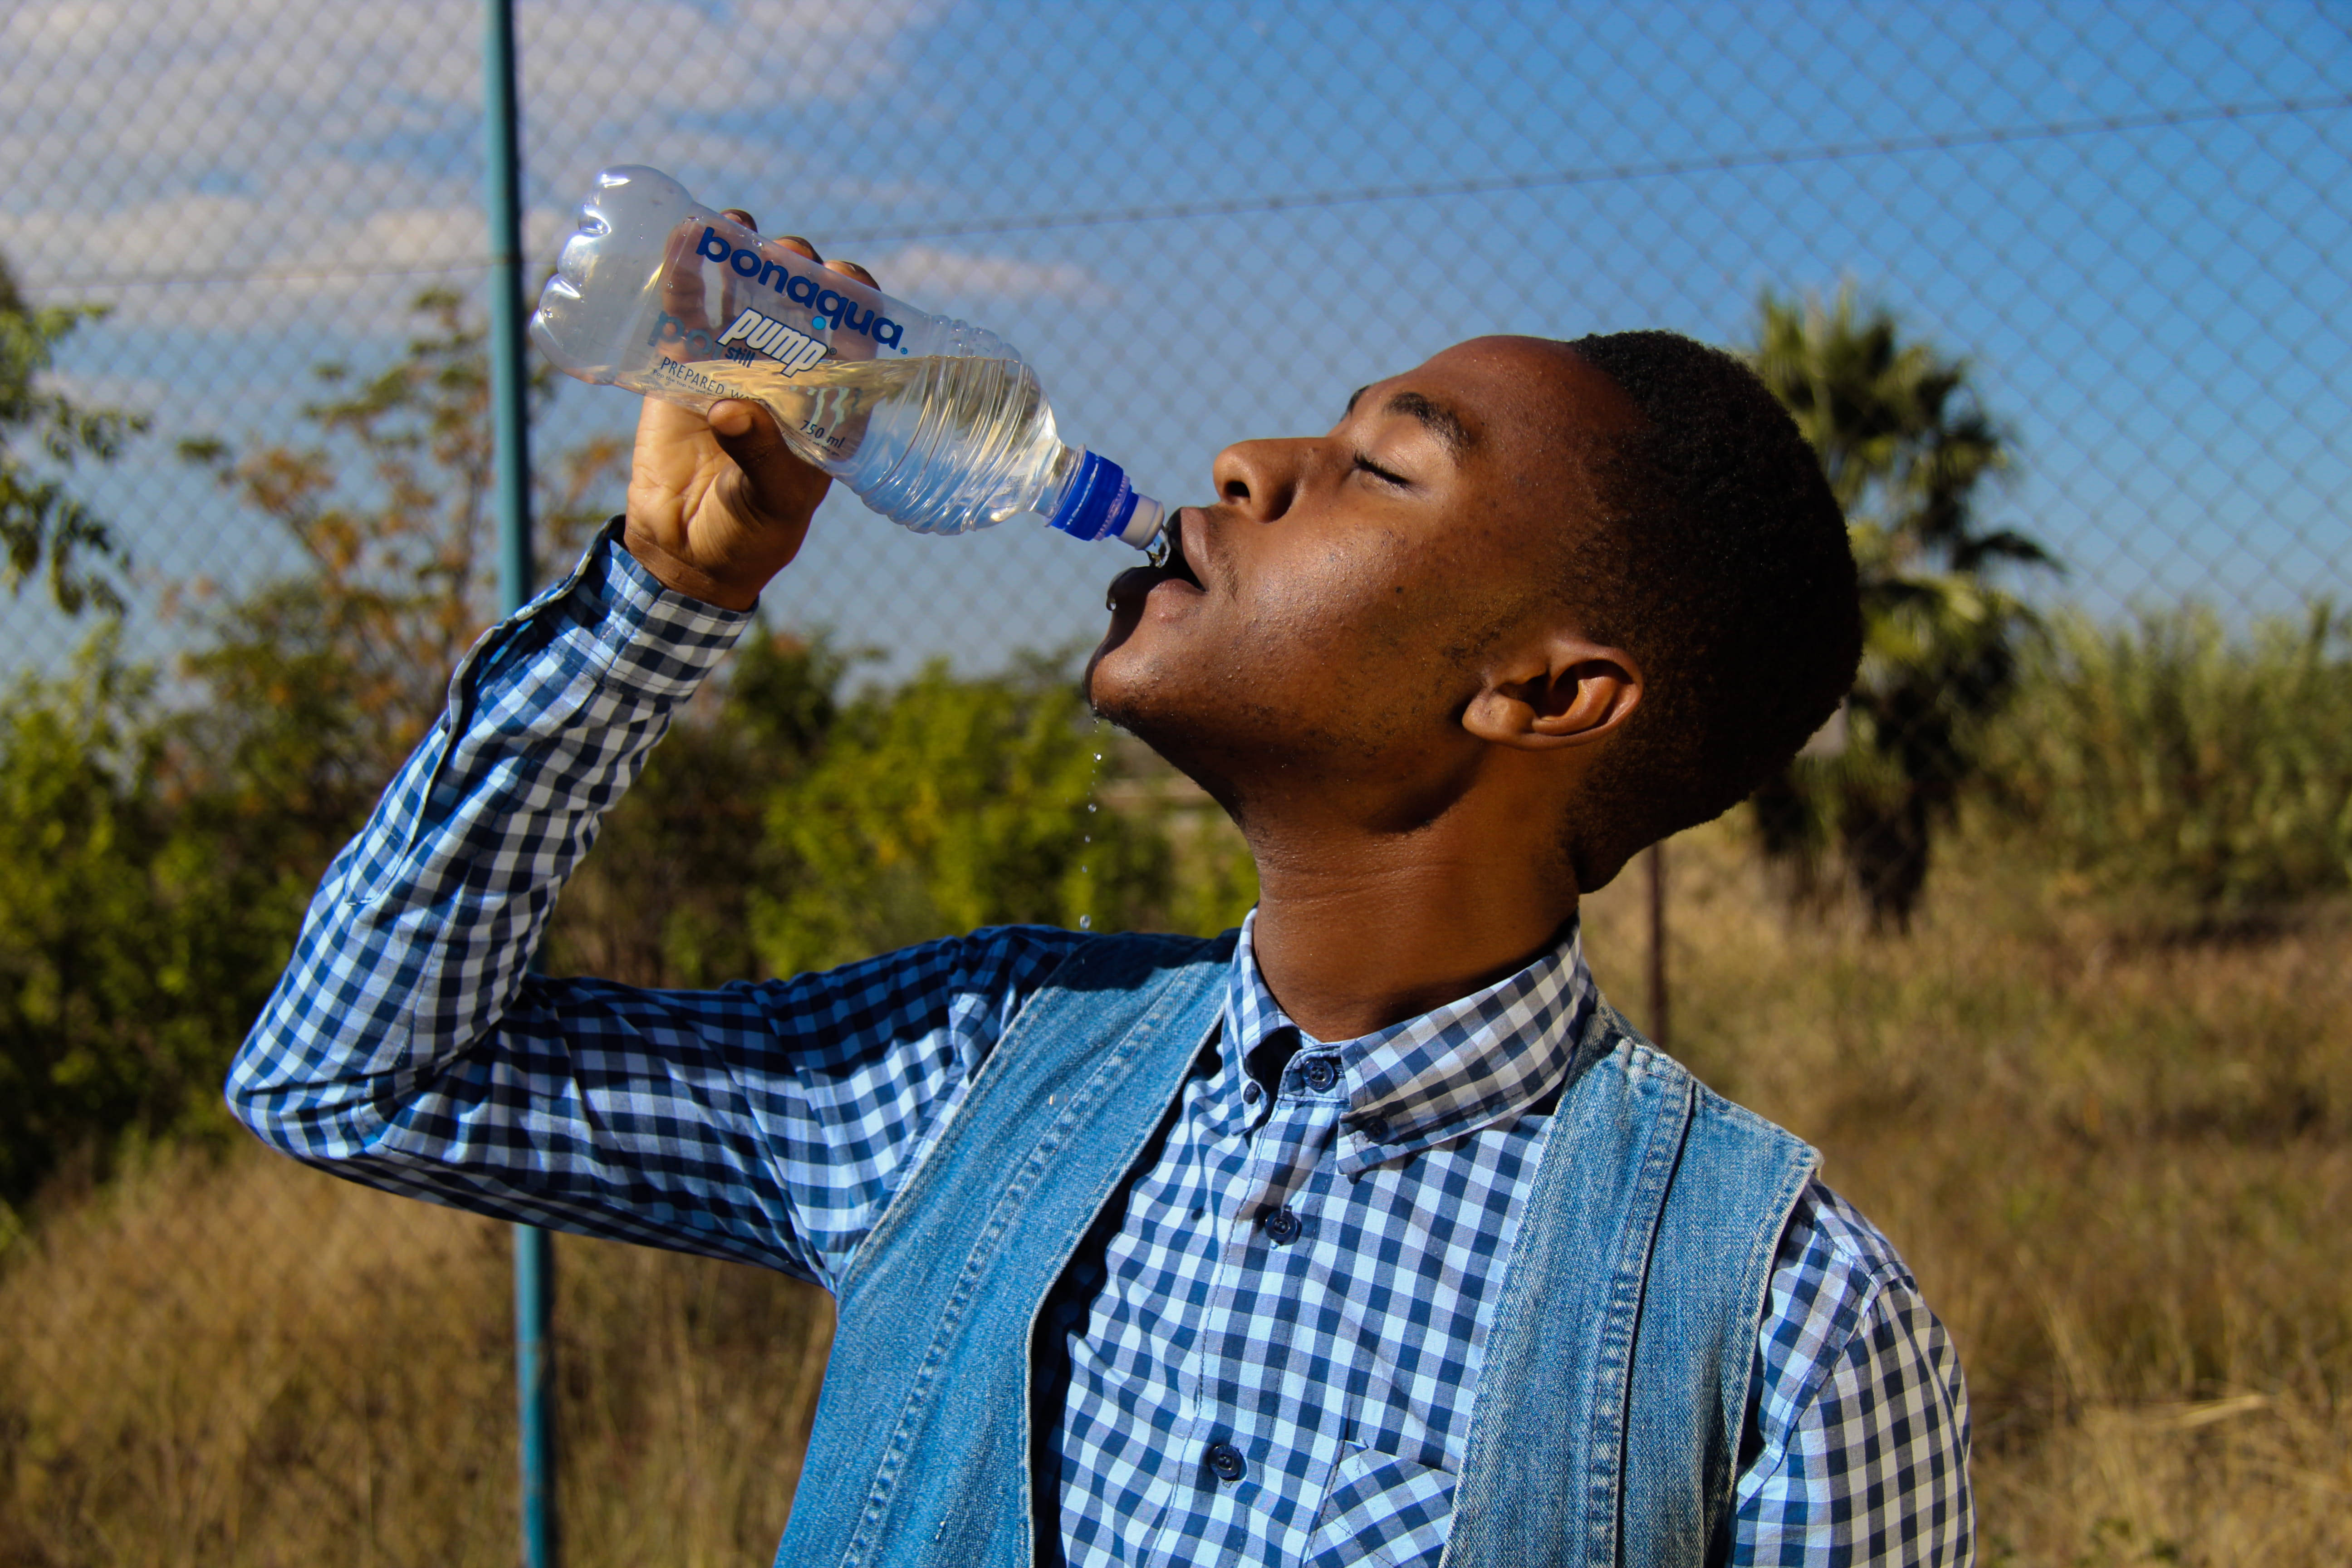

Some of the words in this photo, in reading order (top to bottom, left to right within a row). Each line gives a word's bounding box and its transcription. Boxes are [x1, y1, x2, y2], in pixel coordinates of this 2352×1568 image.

[696, 226, 904, 350] bonaqua
[715, 306, 828, 378] pump
[725, 346, 756, 368] still
[653, 369, 664, 378] Pop
[660, 357, 725, 395] PREPARED
[799, 420, 825, 439] 750
[827, 436, 846, 449] ml
